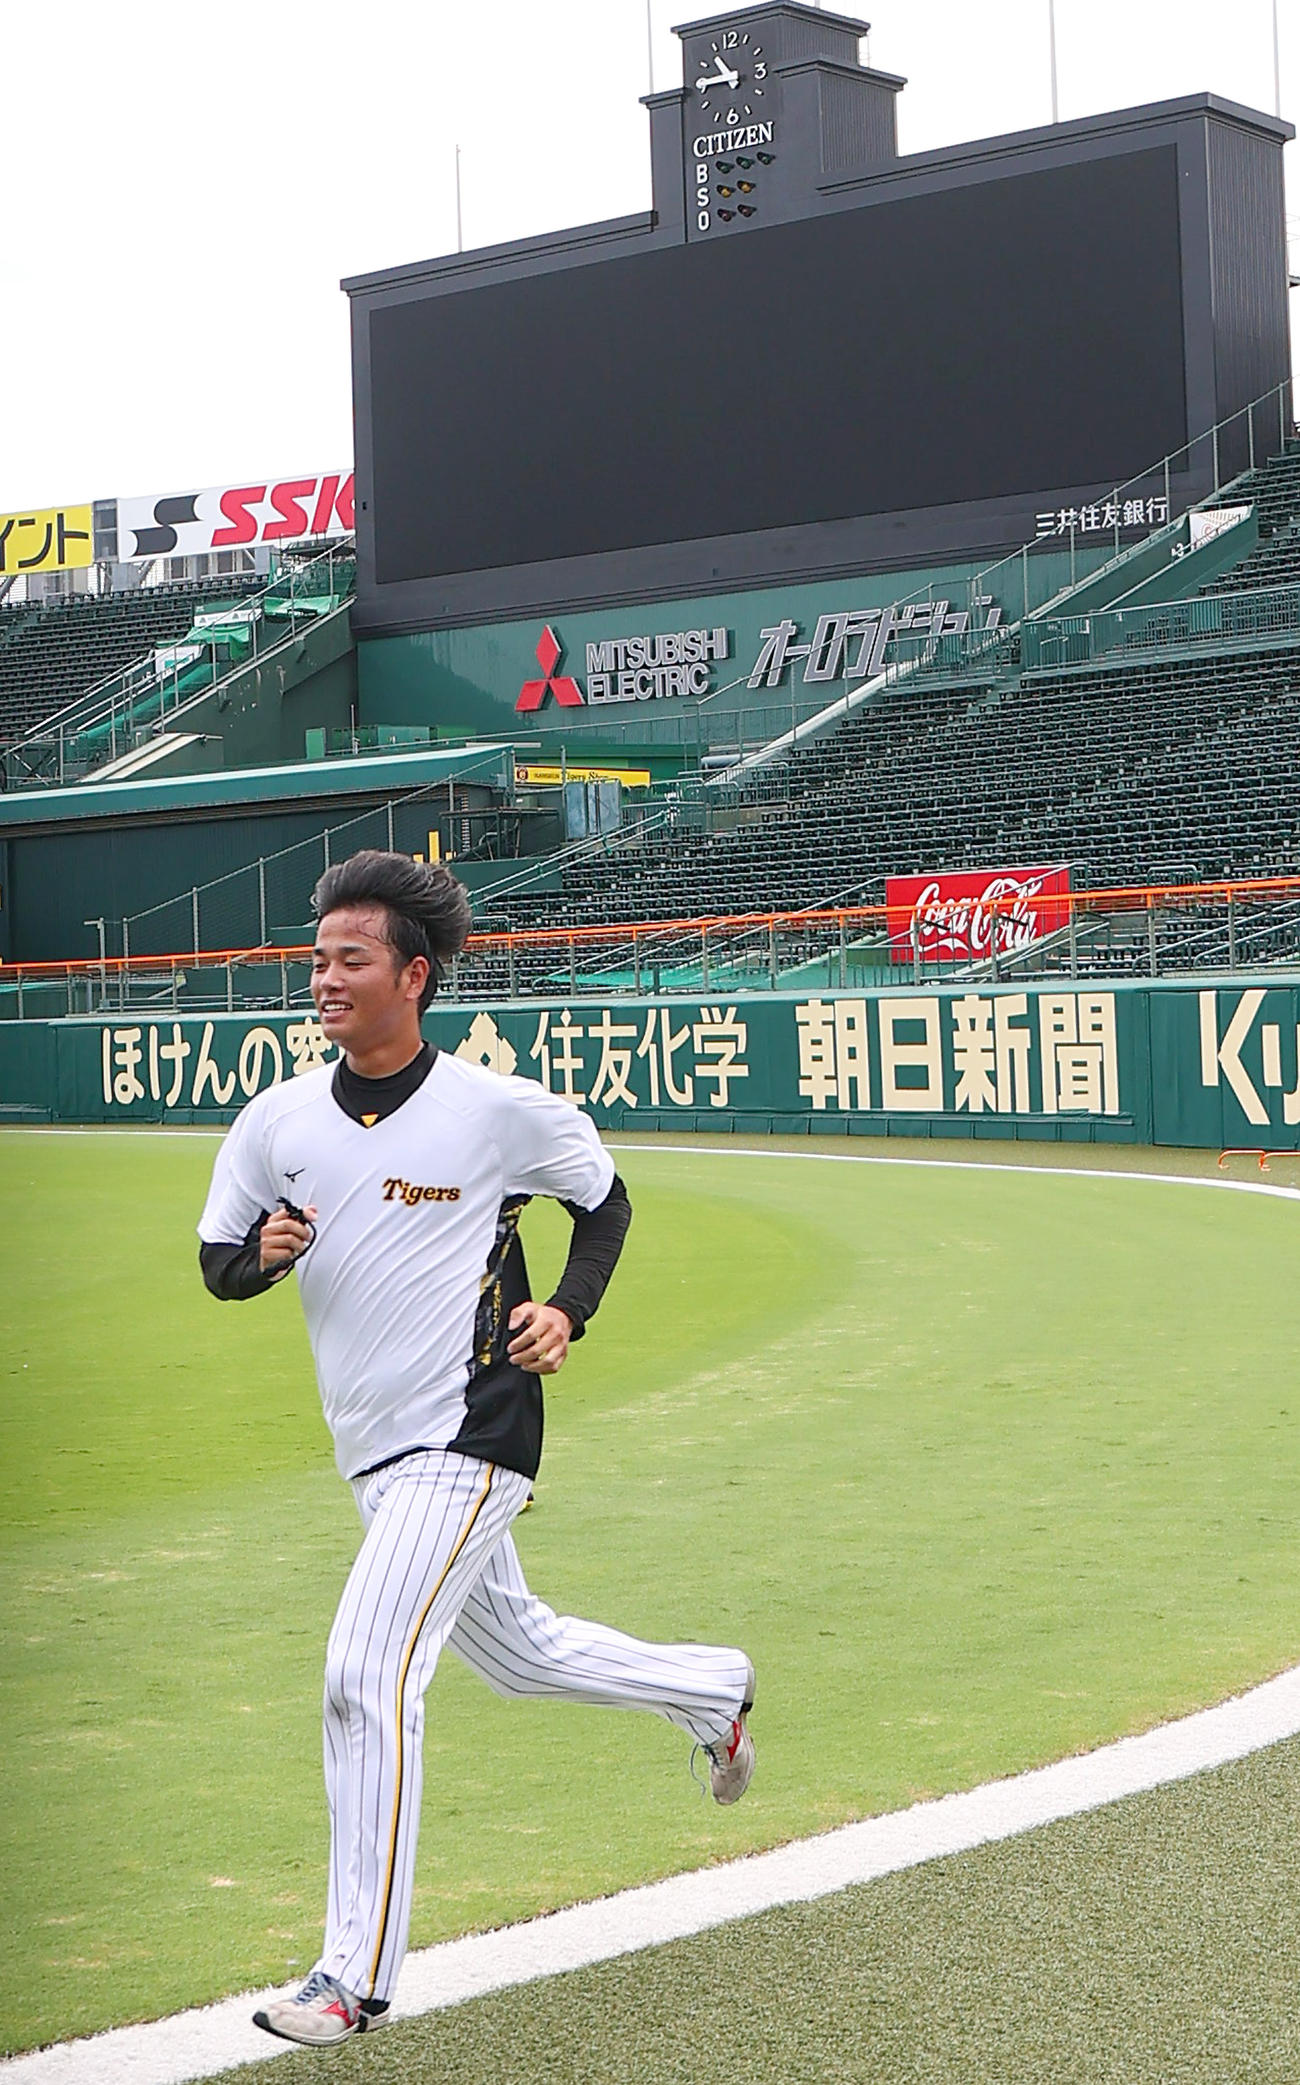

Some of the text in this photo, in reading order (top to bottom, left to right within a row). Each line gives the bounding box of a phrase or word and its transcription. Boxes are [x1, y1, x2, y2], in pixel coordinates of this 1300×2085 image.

[722, 31, 738, 49] 12
[754, 62, 767, 80] 3
[726, 108, 739, 125] 6
[693, 121, 774, 158] CITIZEN
[696, 163, 709, 184] B
[696, 187, 709, 207] S
[211, 473, 354, 547] SSK
[1035, 496, 1168, 537] 三井住友銀行
[585, 628, 729, 673] MITSUBISHI
[586, 663, 709, 706] ELECTRIC
[102, 1016, 345, 1107] ほけんの窓
[529, 1005, 750, 1109] 住友化学
[795, 992, 1120, 1115] 朝日新聞
[382, 1178, 461, 1206] Tigers
